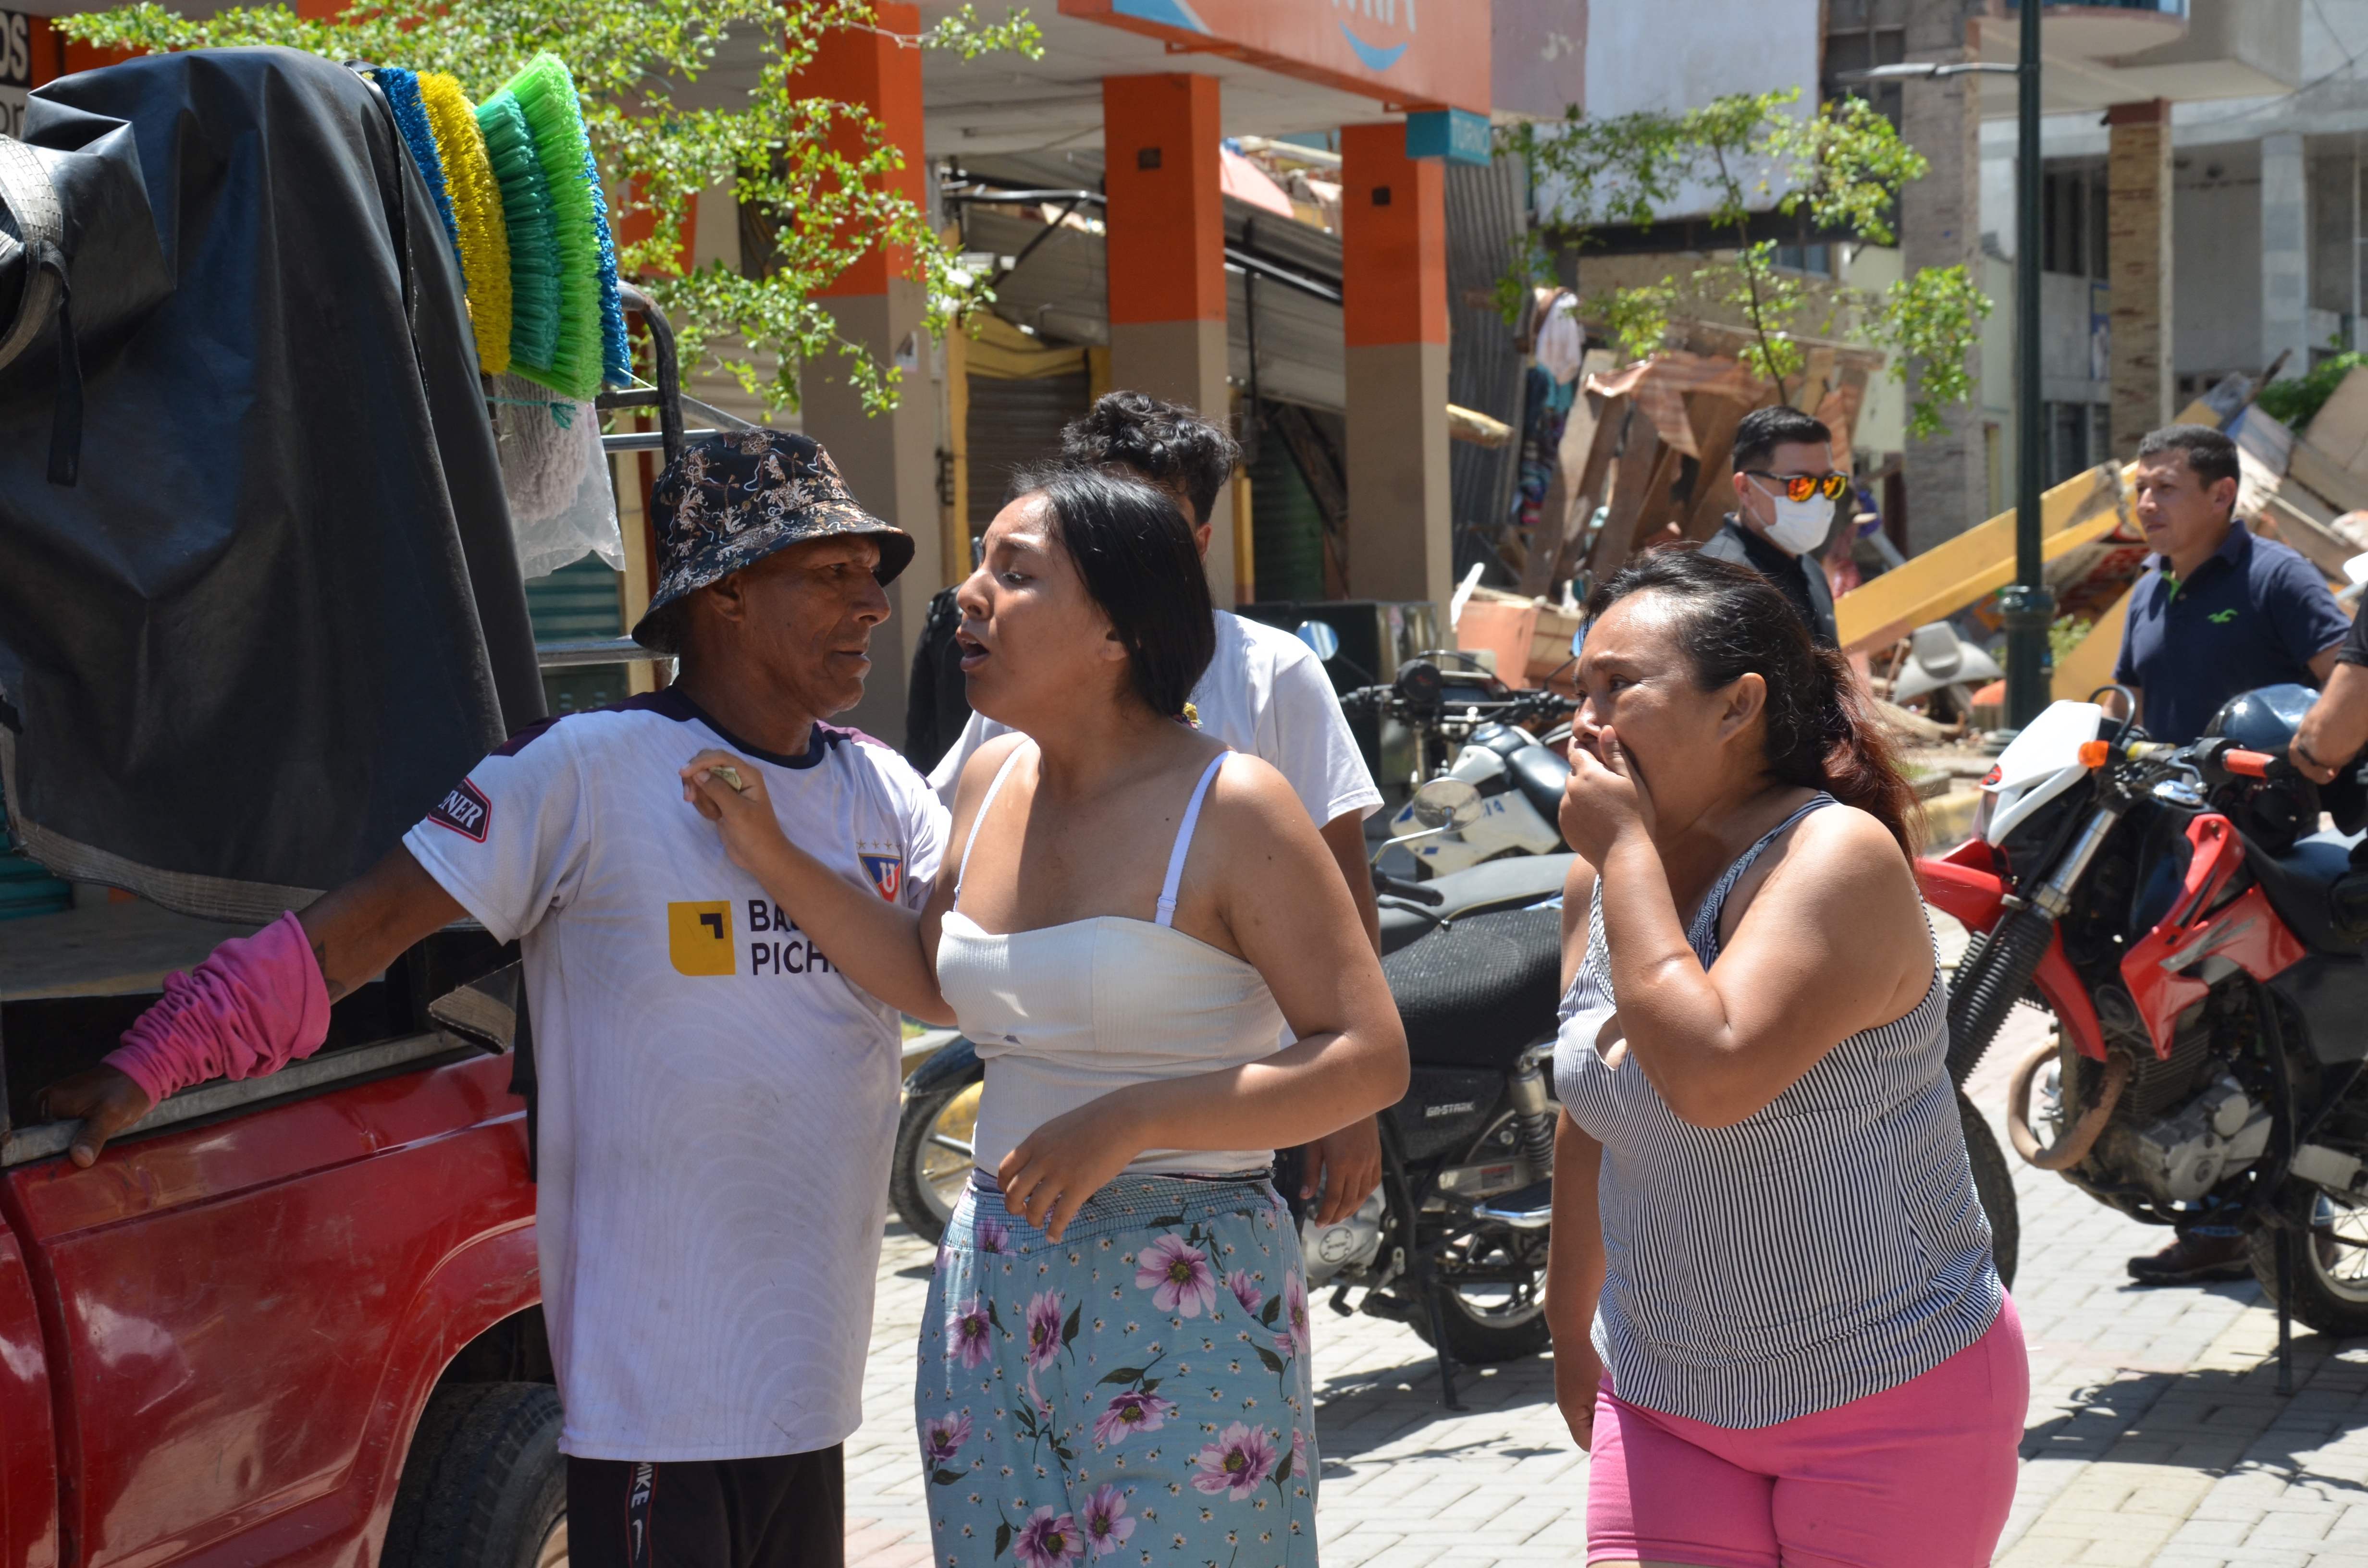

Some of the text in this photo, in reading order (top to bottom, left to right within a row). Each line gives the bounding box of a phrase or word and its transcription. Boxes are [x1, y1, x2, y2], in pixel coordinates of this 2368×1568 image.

[438, 789, 483, 828] NER
[879, 861, 896, 893] U
[748, 899, 800, 932] BA
[751, 940, 839, 975] PICH
